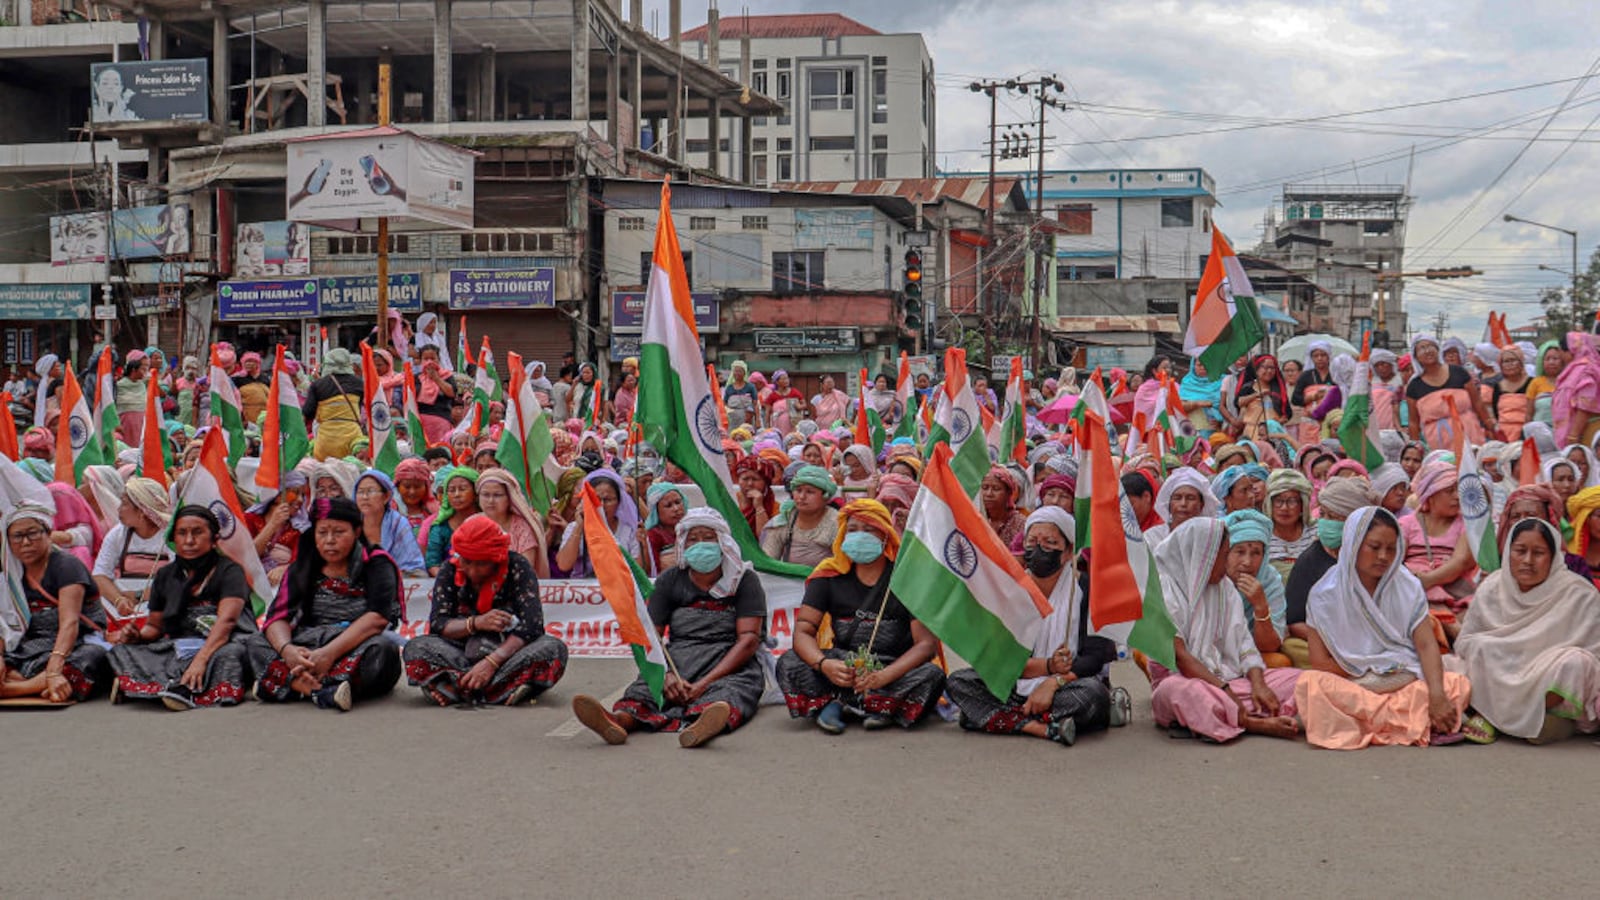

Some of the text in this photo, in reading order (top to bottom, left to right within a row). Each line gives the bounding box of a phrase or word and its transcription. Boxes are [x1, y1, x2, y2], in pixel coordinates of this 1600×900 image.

[162, 73, 180, 84] Salon
[188, 72, 202, 85] Spa
[340, 168, 353, 176] Big
[454, 280, 551, 294] GS STATIONERY
[56, 290, 82, 300] CLINIC
[260, 288, 305, 300] PHARMACY
[322, 284, 419, 304] AC PHARACY
[544, 619, 622, 640] SING
